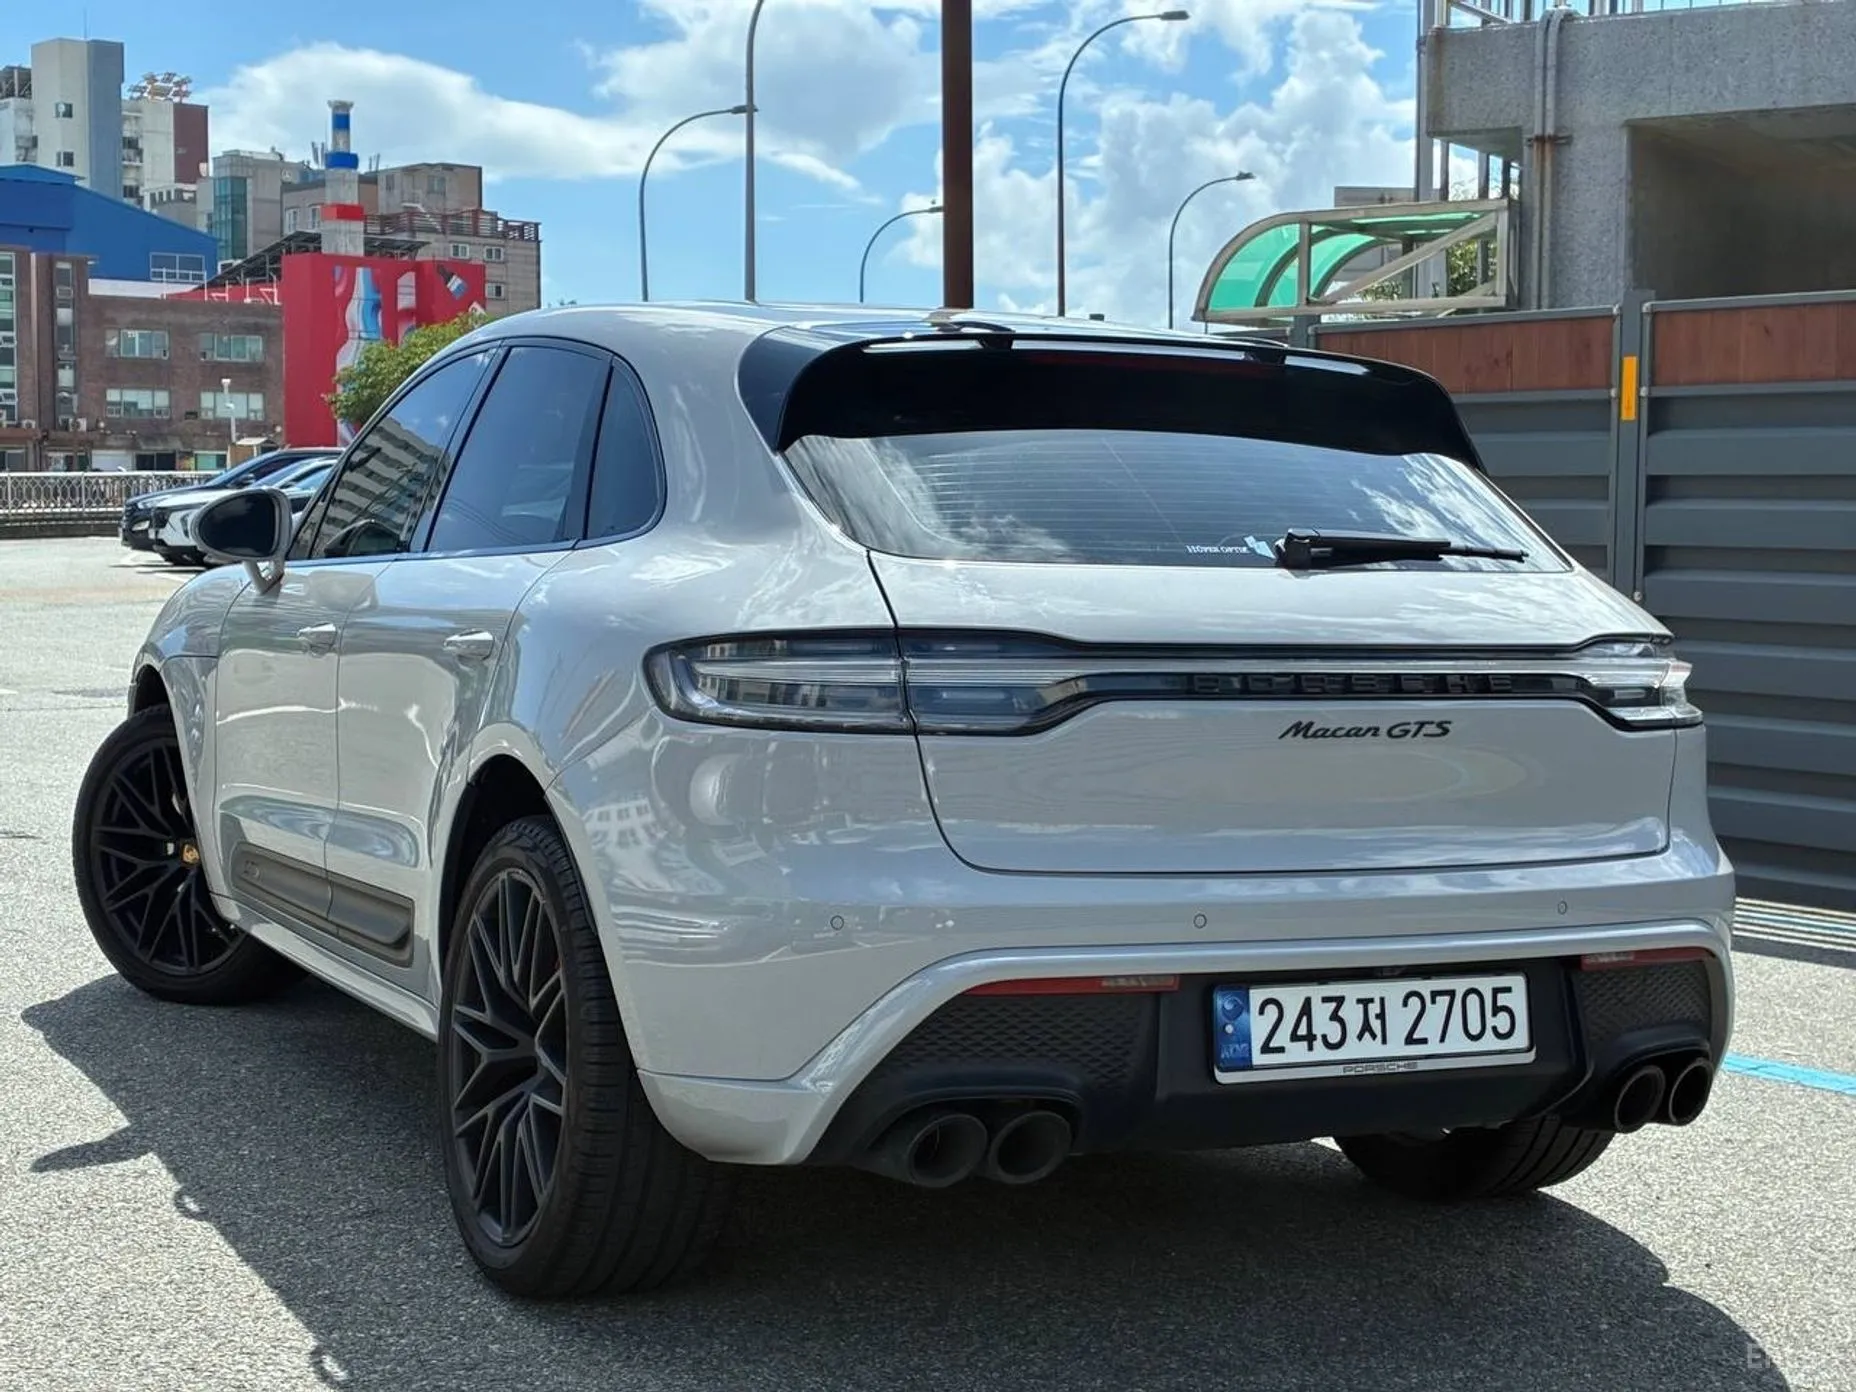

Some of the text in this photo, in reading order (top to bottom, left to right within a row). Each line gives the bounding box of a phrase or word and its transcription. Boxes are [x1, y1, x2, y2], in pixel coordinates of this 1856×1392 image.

[1279, 720, 1452, 739] Macan GTS
[1258, 985, 1516, 1054] 243저 2705
[1342, 1062, 1418, 1075] PORSCHE
